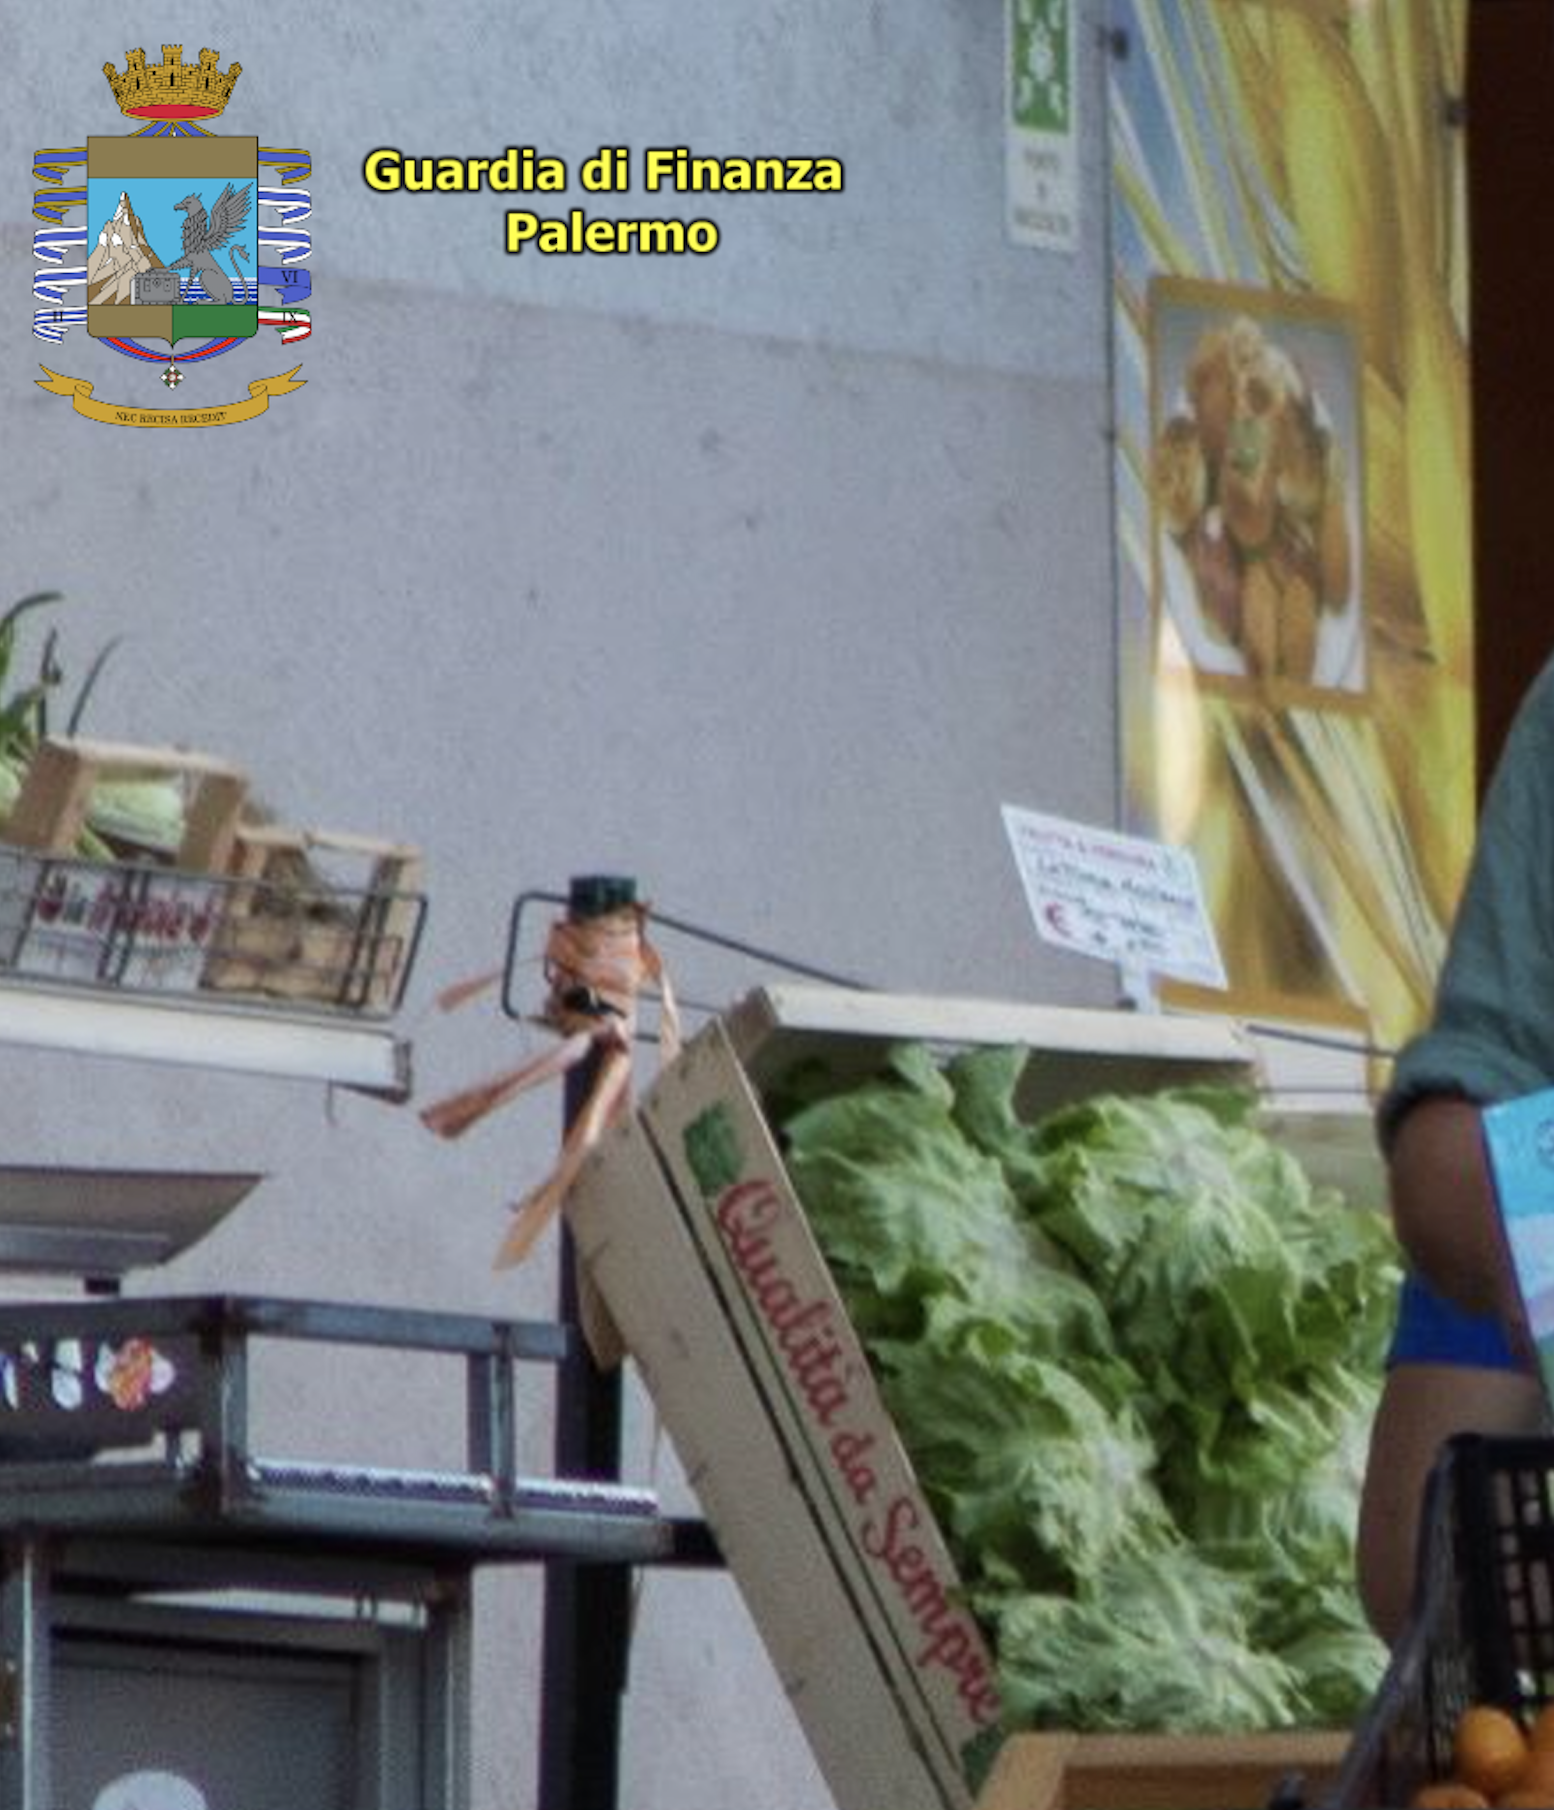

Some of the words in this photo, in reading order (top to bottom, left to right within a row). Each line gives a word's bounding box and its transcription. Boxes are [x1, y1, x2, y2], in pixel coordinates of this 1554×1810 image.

[717, 1180, 859, 1426] Qualità
[831, 1428, 876, 1504] da
[862, 1496, 1000, 1722] Sempre
